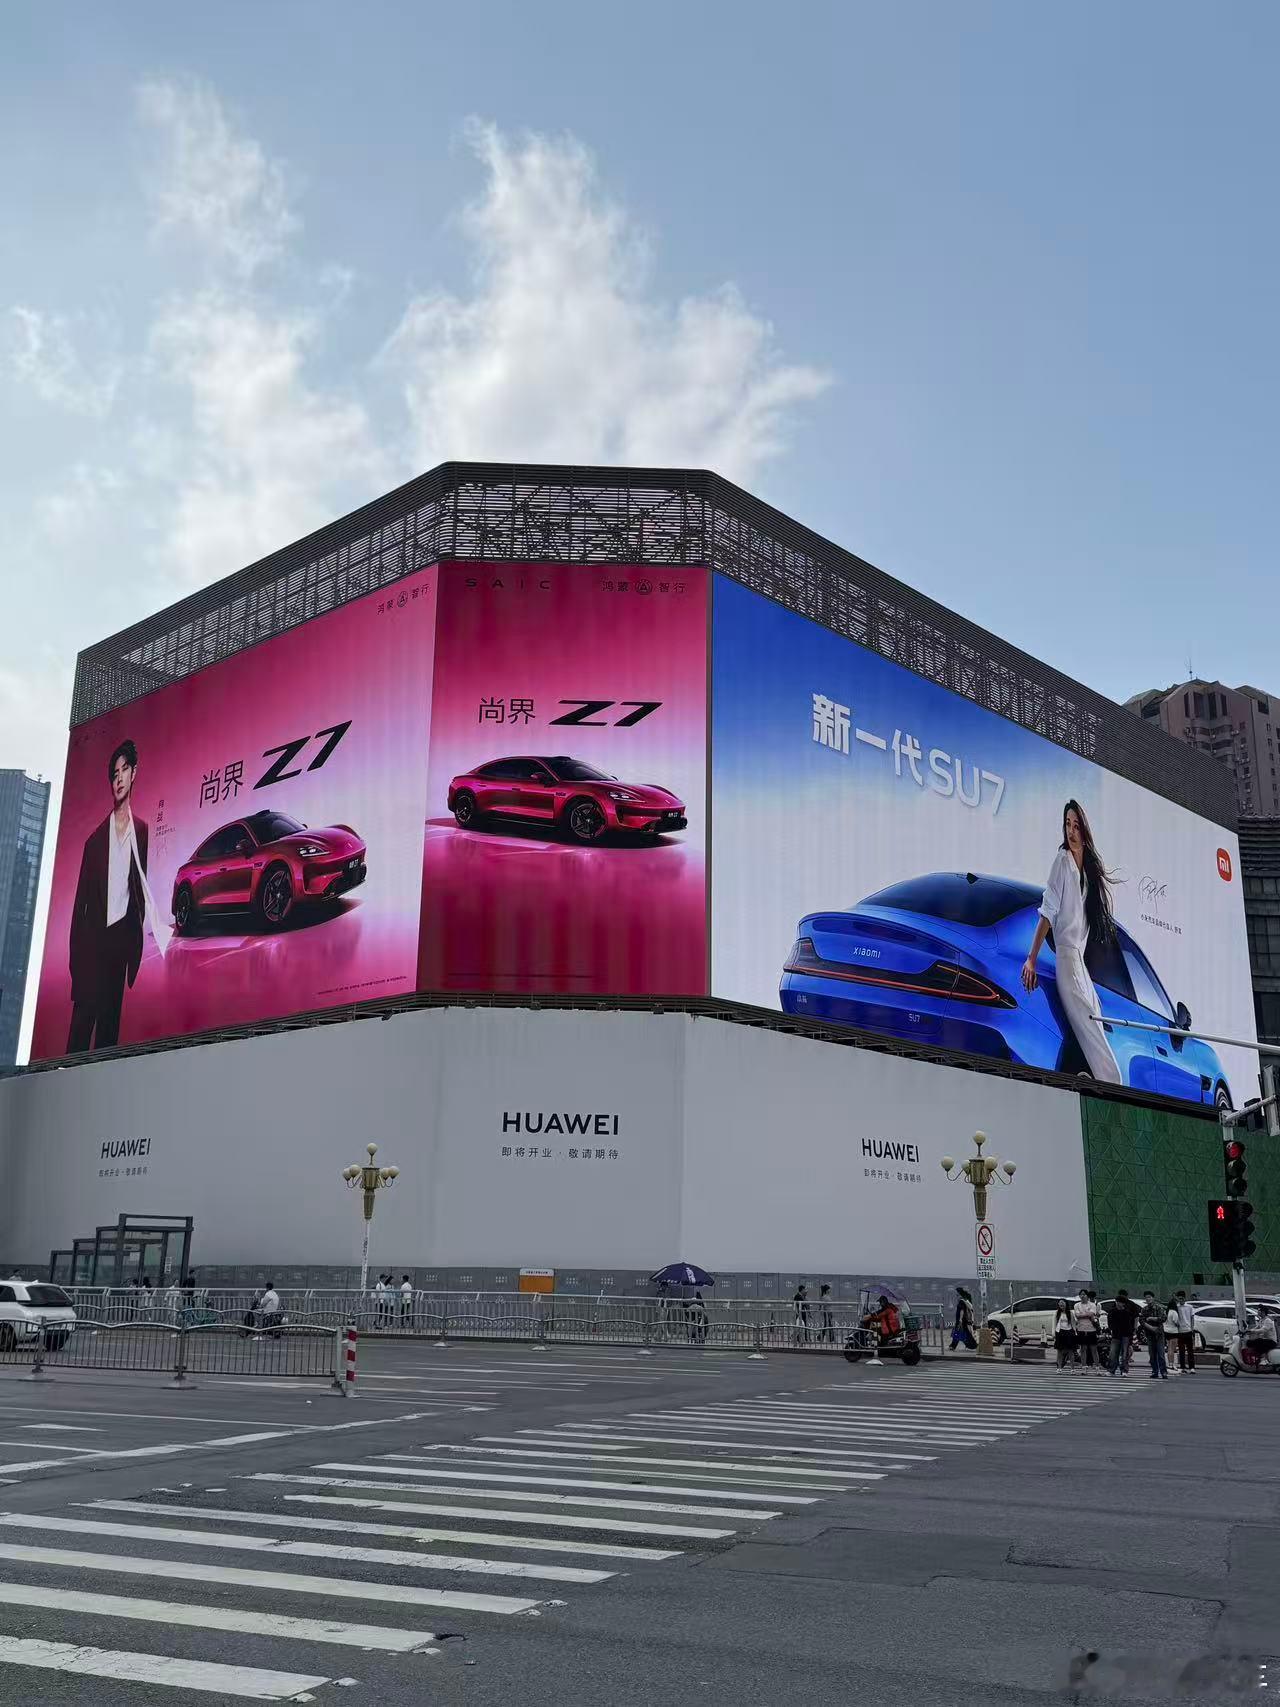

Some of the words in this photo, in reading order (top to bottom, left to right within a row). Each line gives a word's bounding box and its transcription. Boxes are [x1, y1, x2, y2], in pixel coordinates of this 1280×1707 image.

[465, 578, 550, 590] SAIC
[658, 581, 686, 593] 智行
[478, 697, 536, 724] 尚界
[548, 700, 663, 728] Z7
[199, 759, 244, 809] 尚界
[252, 719, 353, 790] Z7
[812, 693, 1006, 816] 新一代SU7
[909, 1013, 921, 1023] SU7
[502, 1111, 619, 1136] HUAWEI
[100, 1137, 151, 1159] HUAWEI
[861, 1137, 920, 1163] HUAWEI
